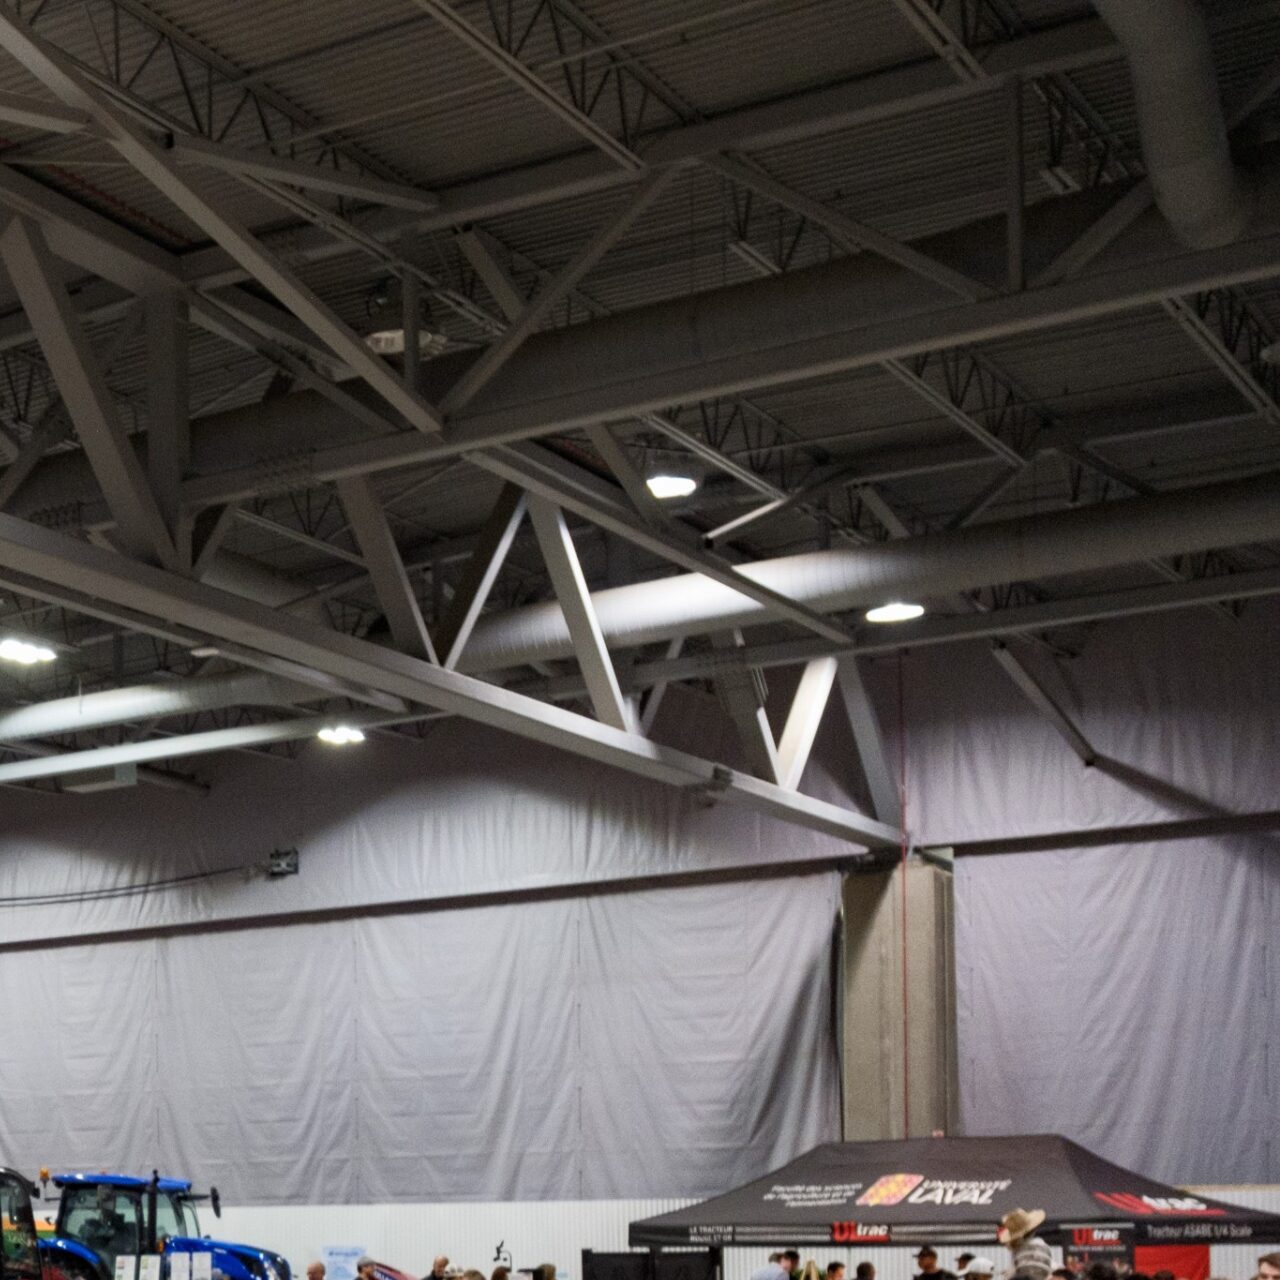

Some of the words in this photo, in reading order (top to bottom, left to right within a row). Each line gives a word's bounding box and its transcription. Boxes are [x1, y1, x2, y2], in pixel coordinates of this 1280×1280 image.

[922, 1178, 1013, 1190] UNIVERSITÉ
[908, 1188, 993, 1205] LAVAL
[1229, 1223, 1253, 1237] Scale
